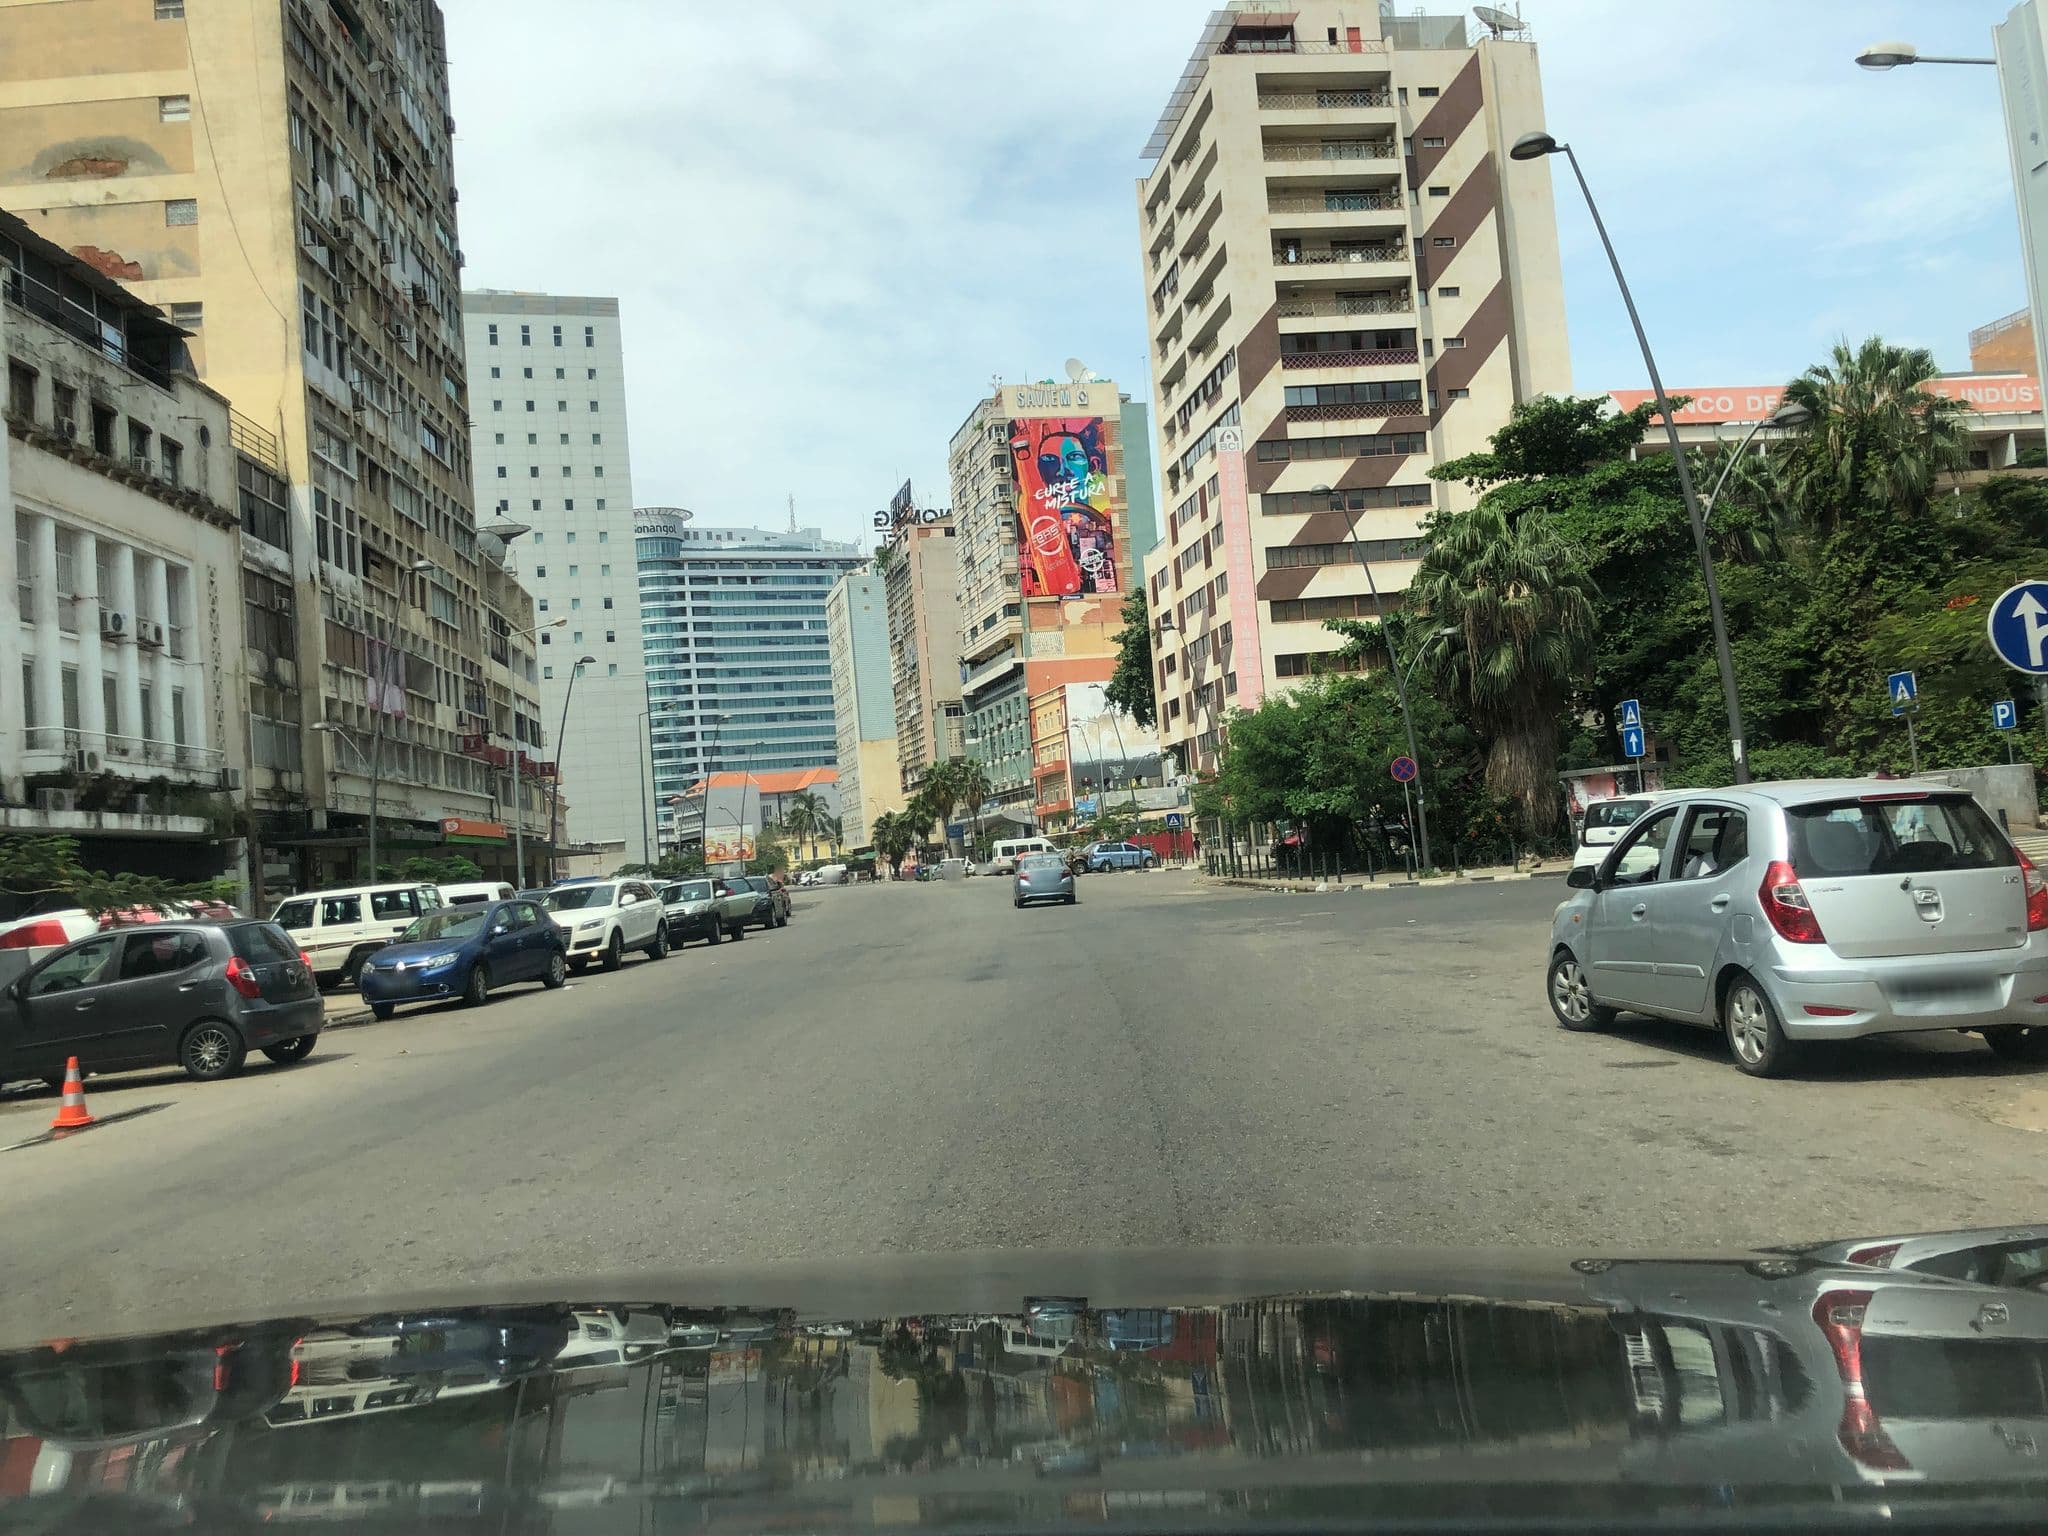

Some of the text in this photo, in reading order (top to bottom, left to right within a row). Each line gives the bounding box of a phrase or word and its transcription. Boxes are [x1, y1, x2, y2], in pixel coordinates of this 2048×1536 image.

[1017, 390, 1071, 407] SAVIEM
[1220, 442, 1240, 451] BCI
[1033, 472, 1094, 500] CURTE A
[1045, 481, 1106, 510] MISTURA
[1996, 704, 2010, 727] P
